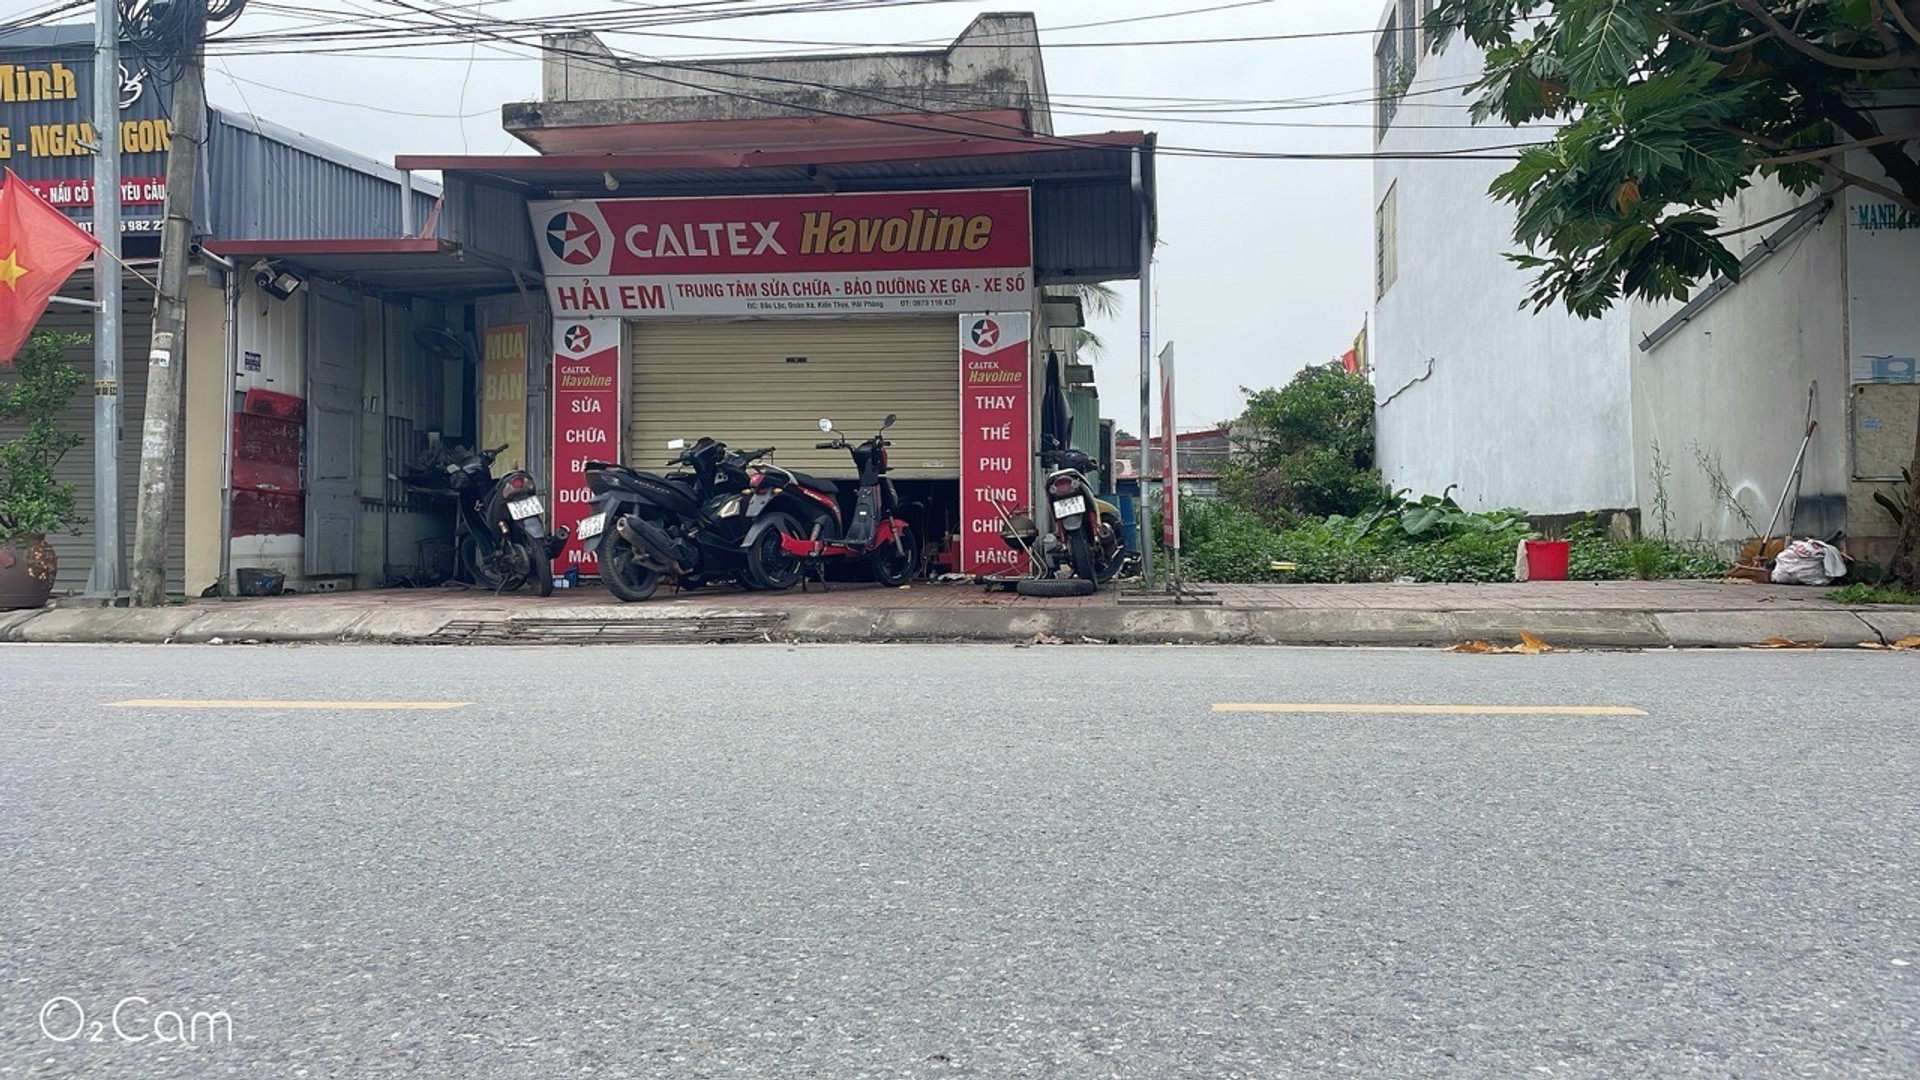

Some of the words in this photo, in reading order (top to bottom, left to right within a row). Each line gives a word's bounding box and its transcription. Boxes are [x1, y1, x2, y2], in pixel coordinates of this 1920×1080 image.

[119, 119, 172, 152] GON
[121, 182, 140, 202] YÊU
[625, 221, 787, 258] CALTEX
[799, 208, 993, 255] Havoline
[676, 283, 724, 298] TRUNG
[726, 280, 757, 297] TÂM
[762, 278, 790, 297] SỬA
[793, 278, 832, 296] CHỮA
[844, 276, 872, 295] BẢO
[876, 277, 925, 295] DƯỠNG
[930, 278, 947, 294] XE
[952, 278, 971, 293] GA
[984, 277, 1002, 292] XE
[1006, 272, 1025, 292] SỐ
[557, 278, 610, 310] HẢI
[619, 284, 666, 309] EM
[485, 332, 523, 361] MUA
[561, 366, 591, 374] CALTEX
[968, 361, 999, 369] CALTEX
[486, 366, 523, 400] BÁN
[561, 375, 612, 387] Havoline
[968, 370, 1022, 382] Havoline
[571, 396, 602, 413] SỬA
[975, 396, 1016, 410] THAY
[487, 412, 521, 442] XE
[566, 427, 606, 443] CHỮA
[981, 422, 1011, 440] THẾ
[980, 457, 1012, 474] PHỤ
[975, 485, 1017, 502] TÙNG
